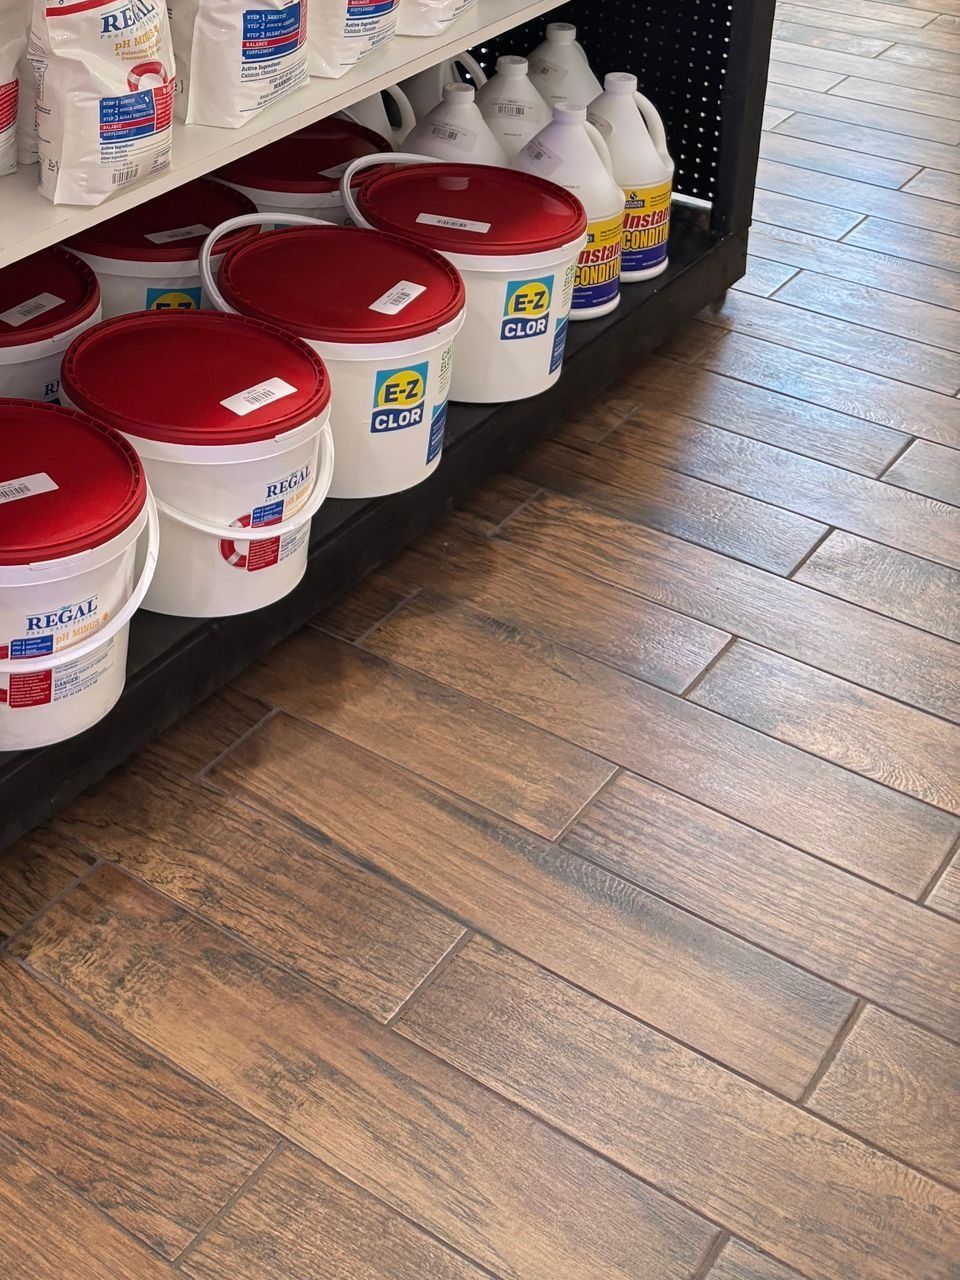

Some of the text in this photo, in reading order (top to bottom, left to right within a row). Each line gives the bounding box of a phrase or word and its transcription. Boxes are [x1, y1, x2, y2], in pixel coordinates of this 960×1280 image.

[115, 40, 131, 51] pH
[513, 290, 546, 312] E-Z
[504, 319, 546, 337] CLOR
[384, 379, 420, 403] E-Z
[374, 409, 421, 430] CLOR
[266, 465, 311, 498] REGAL
[26, 598, 98, 631] REGAL
[56, 619, 100, 643] pH MINUS
